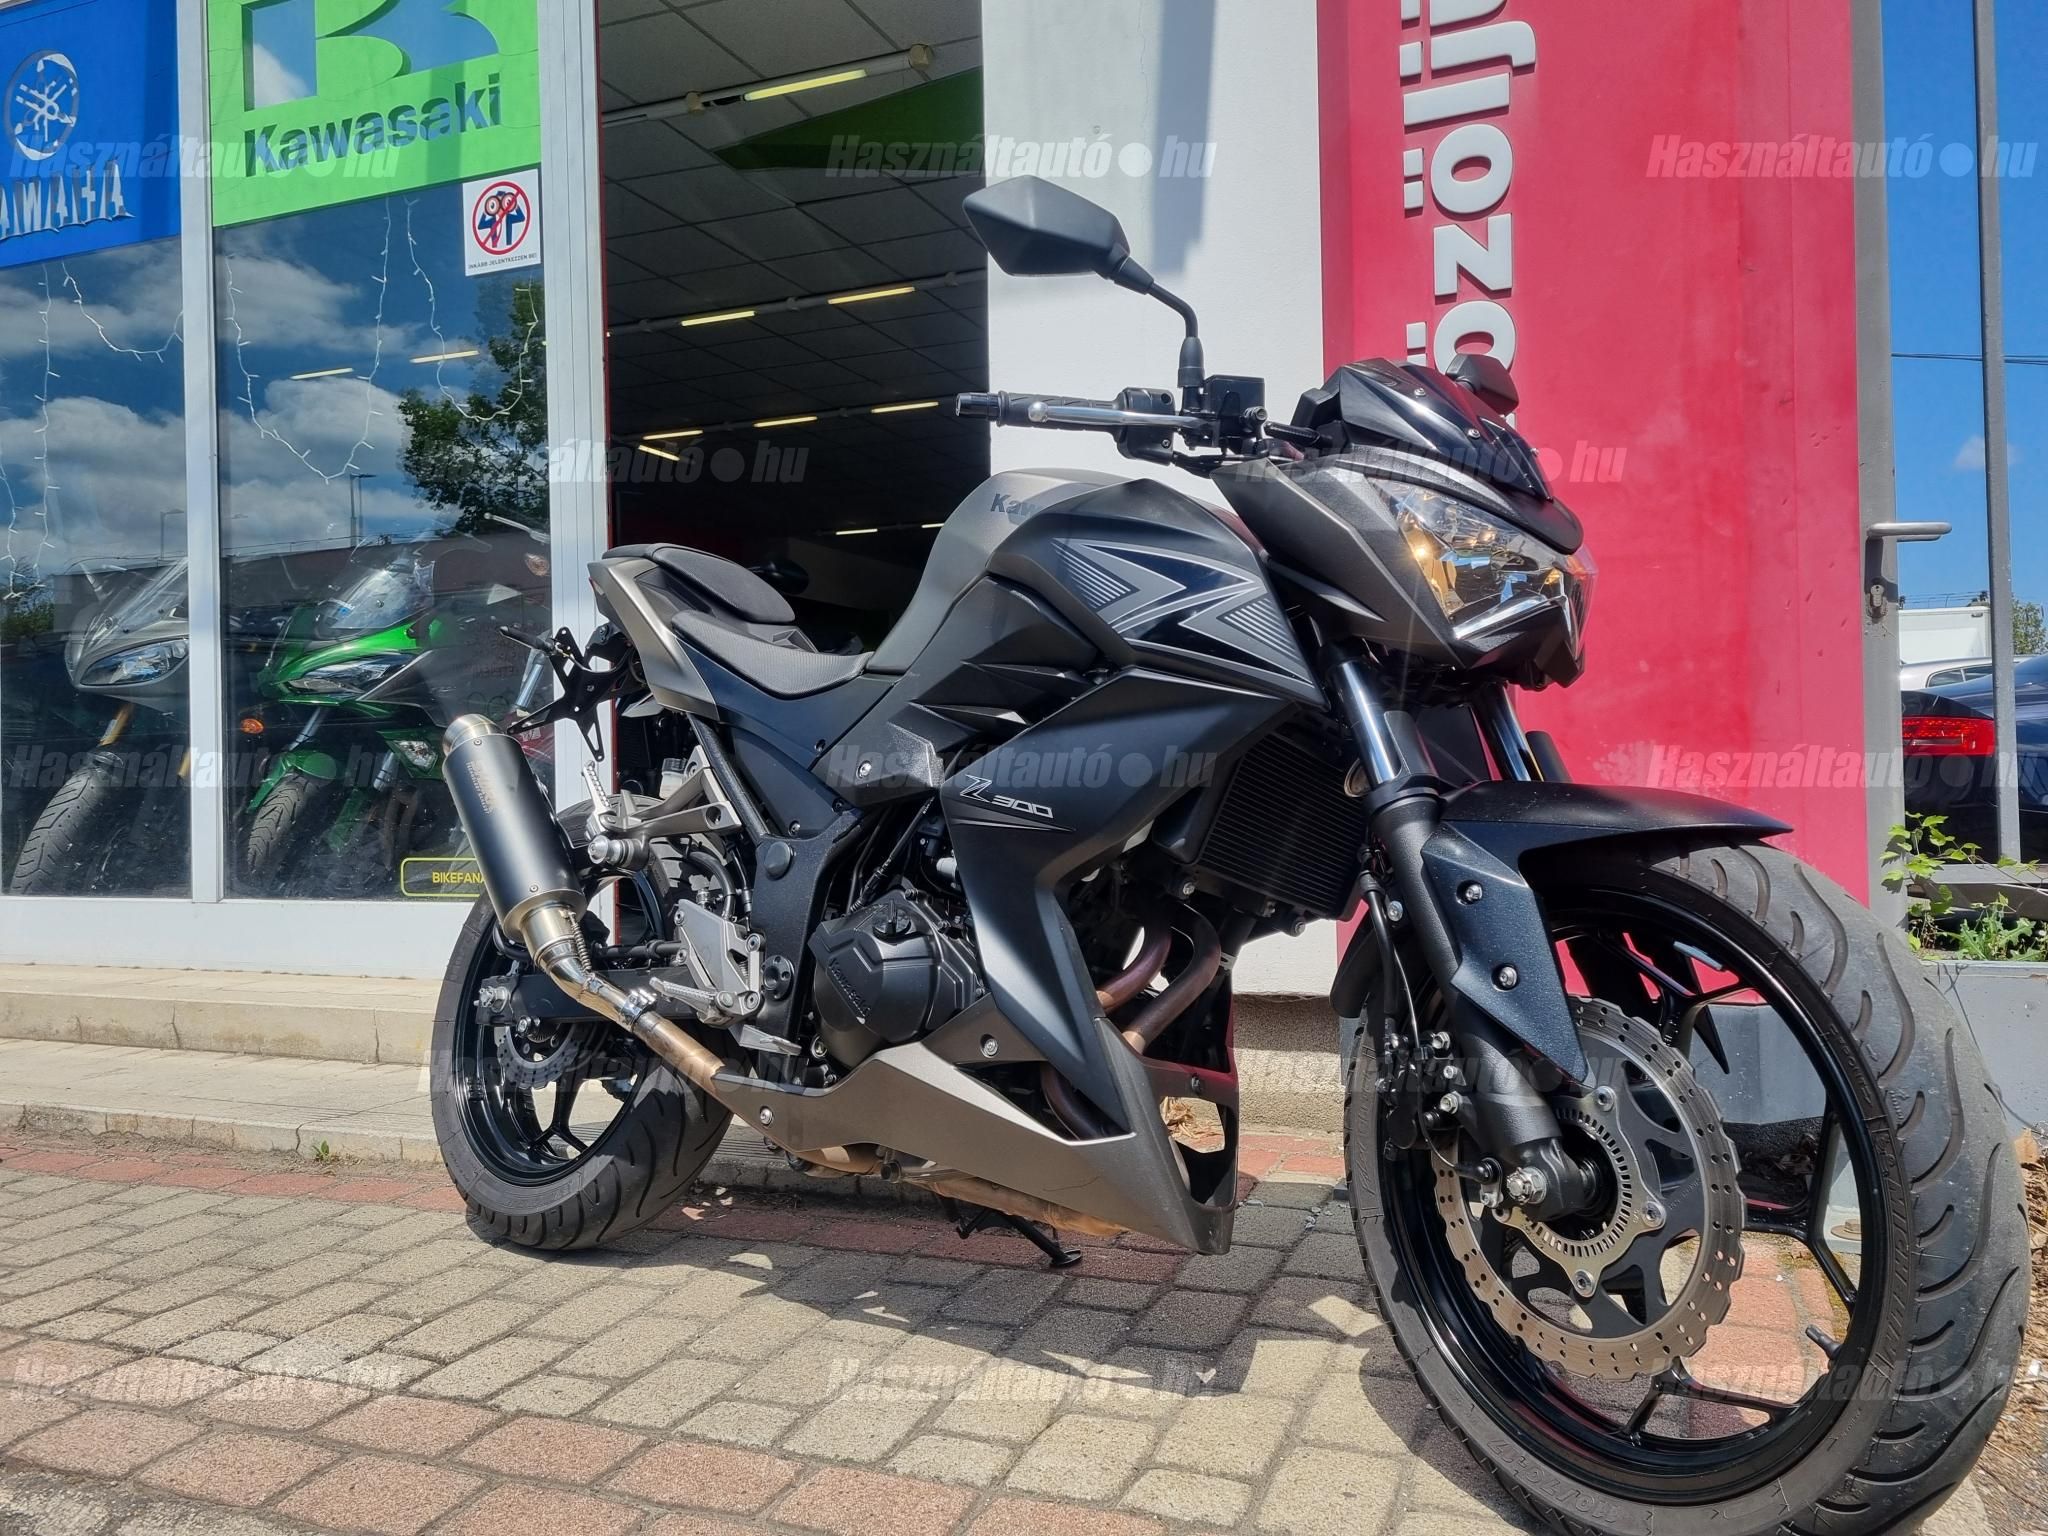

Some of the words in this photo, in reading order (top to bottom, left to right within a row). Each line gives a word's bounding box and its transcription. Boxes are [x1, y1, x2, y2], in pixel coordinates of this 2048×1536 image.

[245, 72, 501, 177] Kawasaki
[1400, 0, 1536, 376] özölj
[990, 492, 1037, 518] Kaw
[991, 794, 1054, 819] 300
